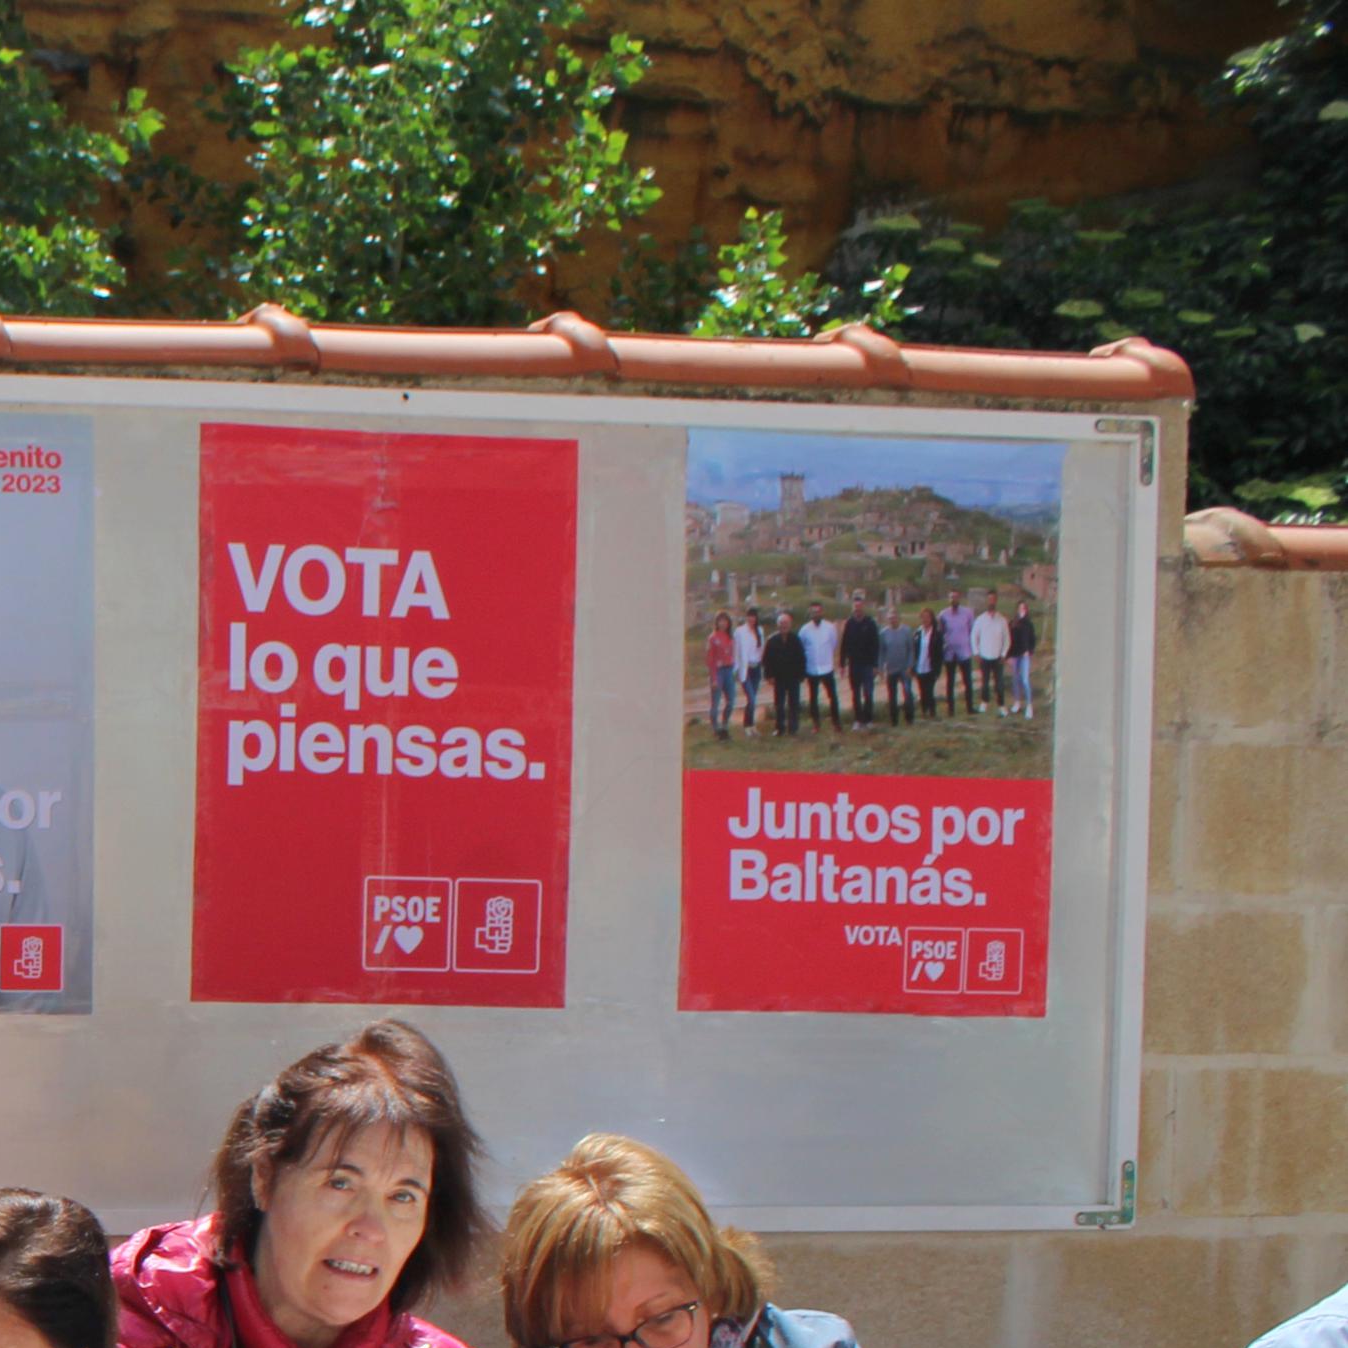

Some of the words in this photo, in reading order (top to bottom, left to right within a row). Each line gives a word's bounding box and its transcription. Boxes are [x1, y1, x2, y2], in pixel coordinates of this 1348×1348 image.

[2, 473, 62, 494] 2023
[227, 542, 451, 620] VOTA
[228, 621, 299, 694] lo
[313, 642, 459, 711] que
[226, 702, 546, 787] piensas.
[727, 787, 921, 845] Juntos
[931, 804, 1026, 855] por
[373, 894, 442, 923] PSOE
[729, 848, 987, 907] Baltanás.
[843, 924, 903, 946] VOTA
[911, 940, 958, 960] PSOE
